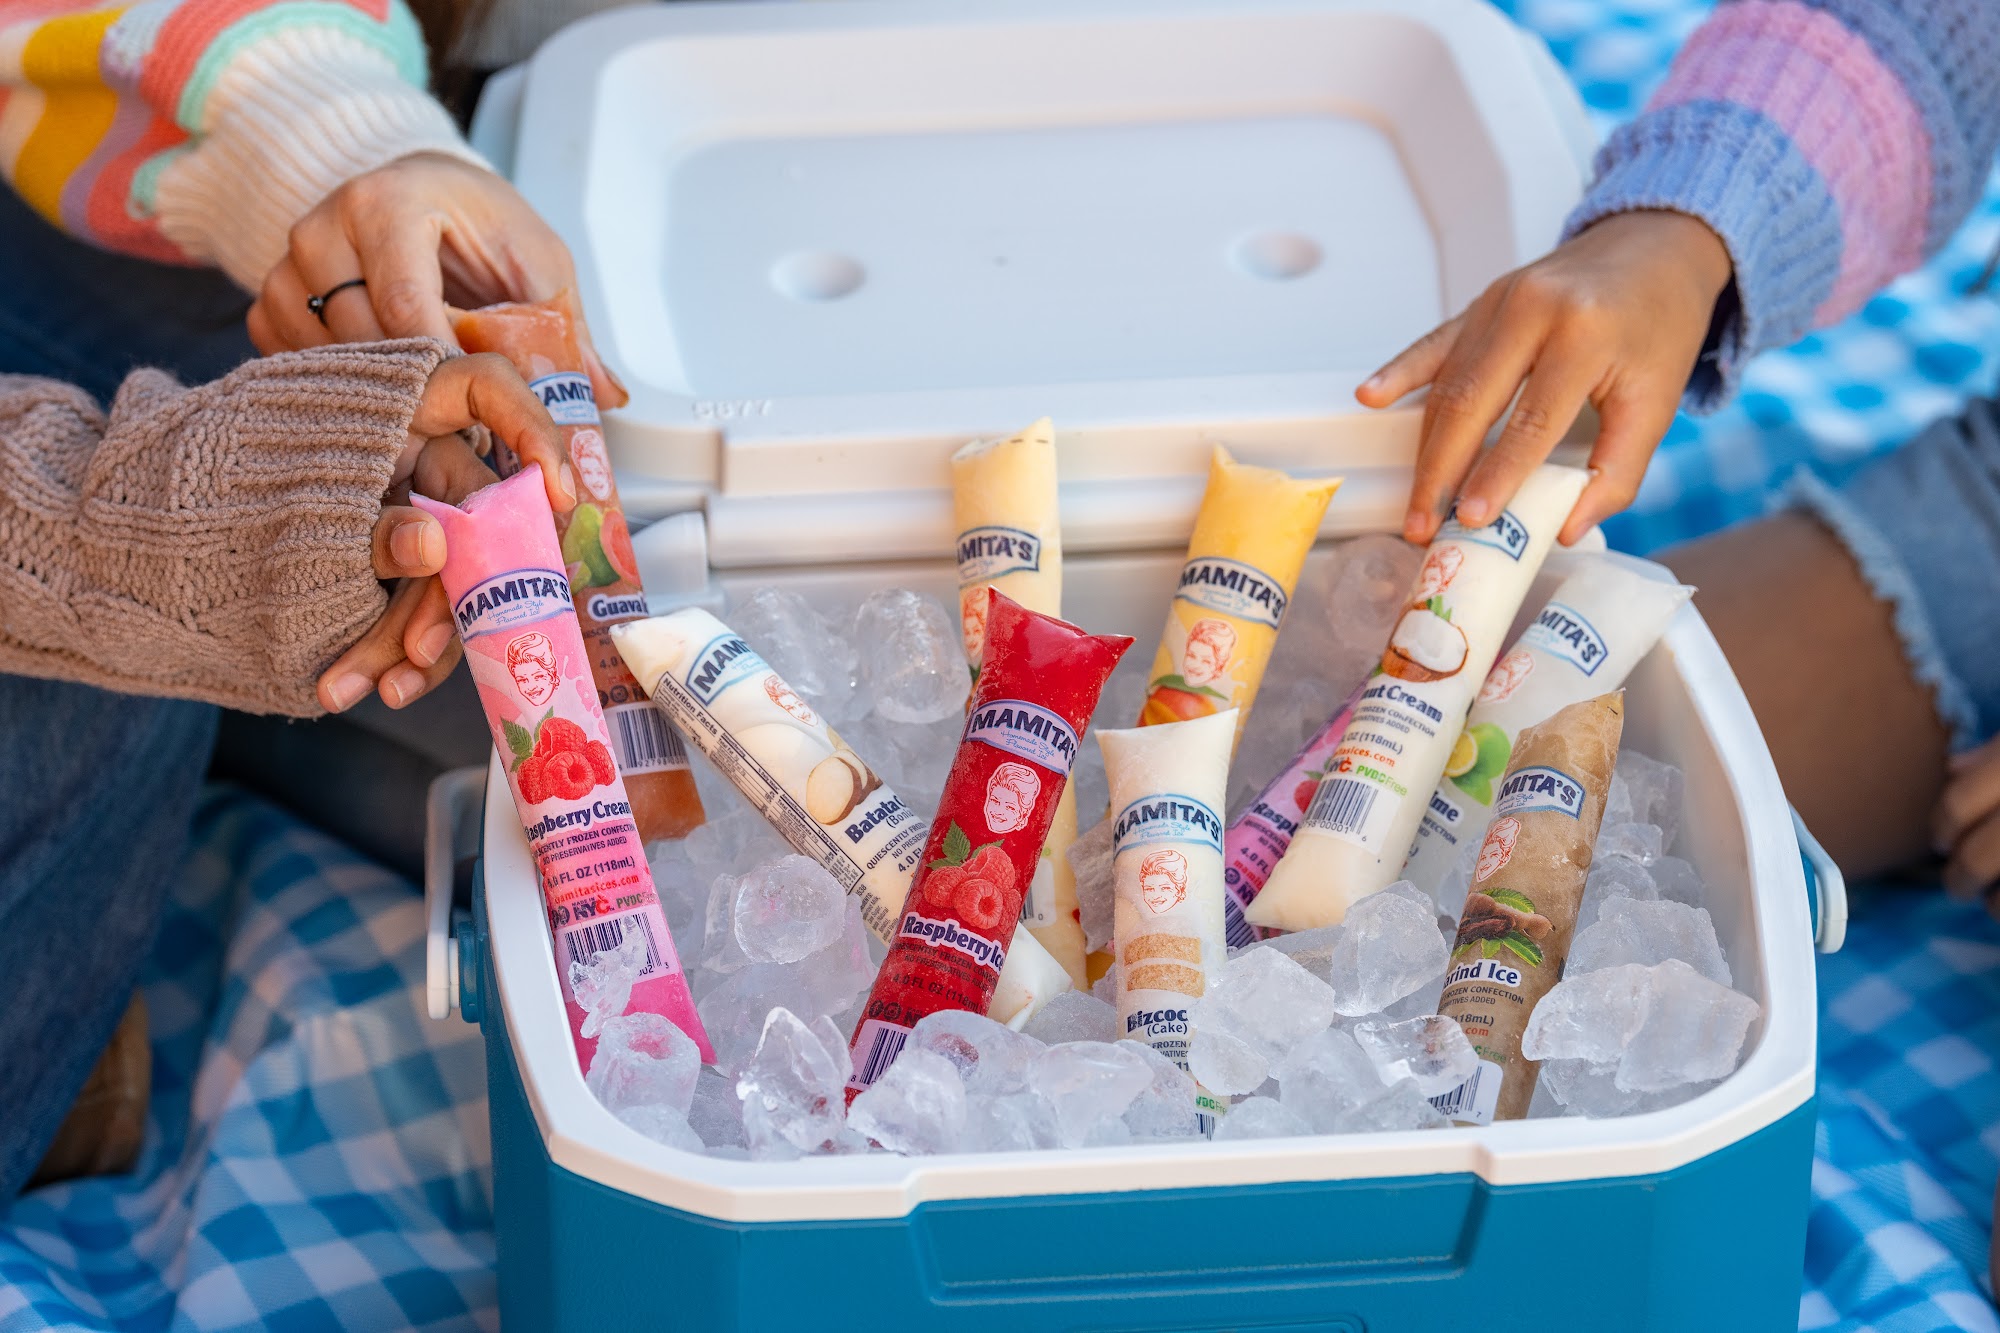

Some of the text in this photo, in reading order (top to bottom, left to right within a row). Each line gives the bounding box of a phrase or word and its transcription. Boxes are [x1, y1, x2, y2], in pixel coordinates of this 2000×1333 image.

[458, 577, 570, 632] MAMITA'S
[592, 598, 642, 617] Guava
[662, 677, 697, 713] Nutrition
[695, 710, 719, 735] Facts
[1387, 685, 1442, 723] Cream
[845, 801, 900, 844] Batata
[566, 829, 600, 845] FROZEN
[551, 841, 606, 862] PRESERVATIVES
[607, 836, 627, 847] ADDED
[866, 830, 909, 869] QUIESCENTLY
[892, 848, 903, 858] NO
[559, 871, 574, 884] FL
[576, 866, 593, 879] OZ
[594, 856, 635, 876] (118mL)
[898, 855, 915, 872] 4.0
[902, 916, 992, 961] Raspberry
[1488, 963, 1518, 984] Ice
[1470, 986, 1524, 1005] CONFECTION
[1470, 996, 1495, 1005] ADDED
[1147, 1023, 1187, 1037] (Cake)
[1152, 1041, 1187, 1049] FROZEN
